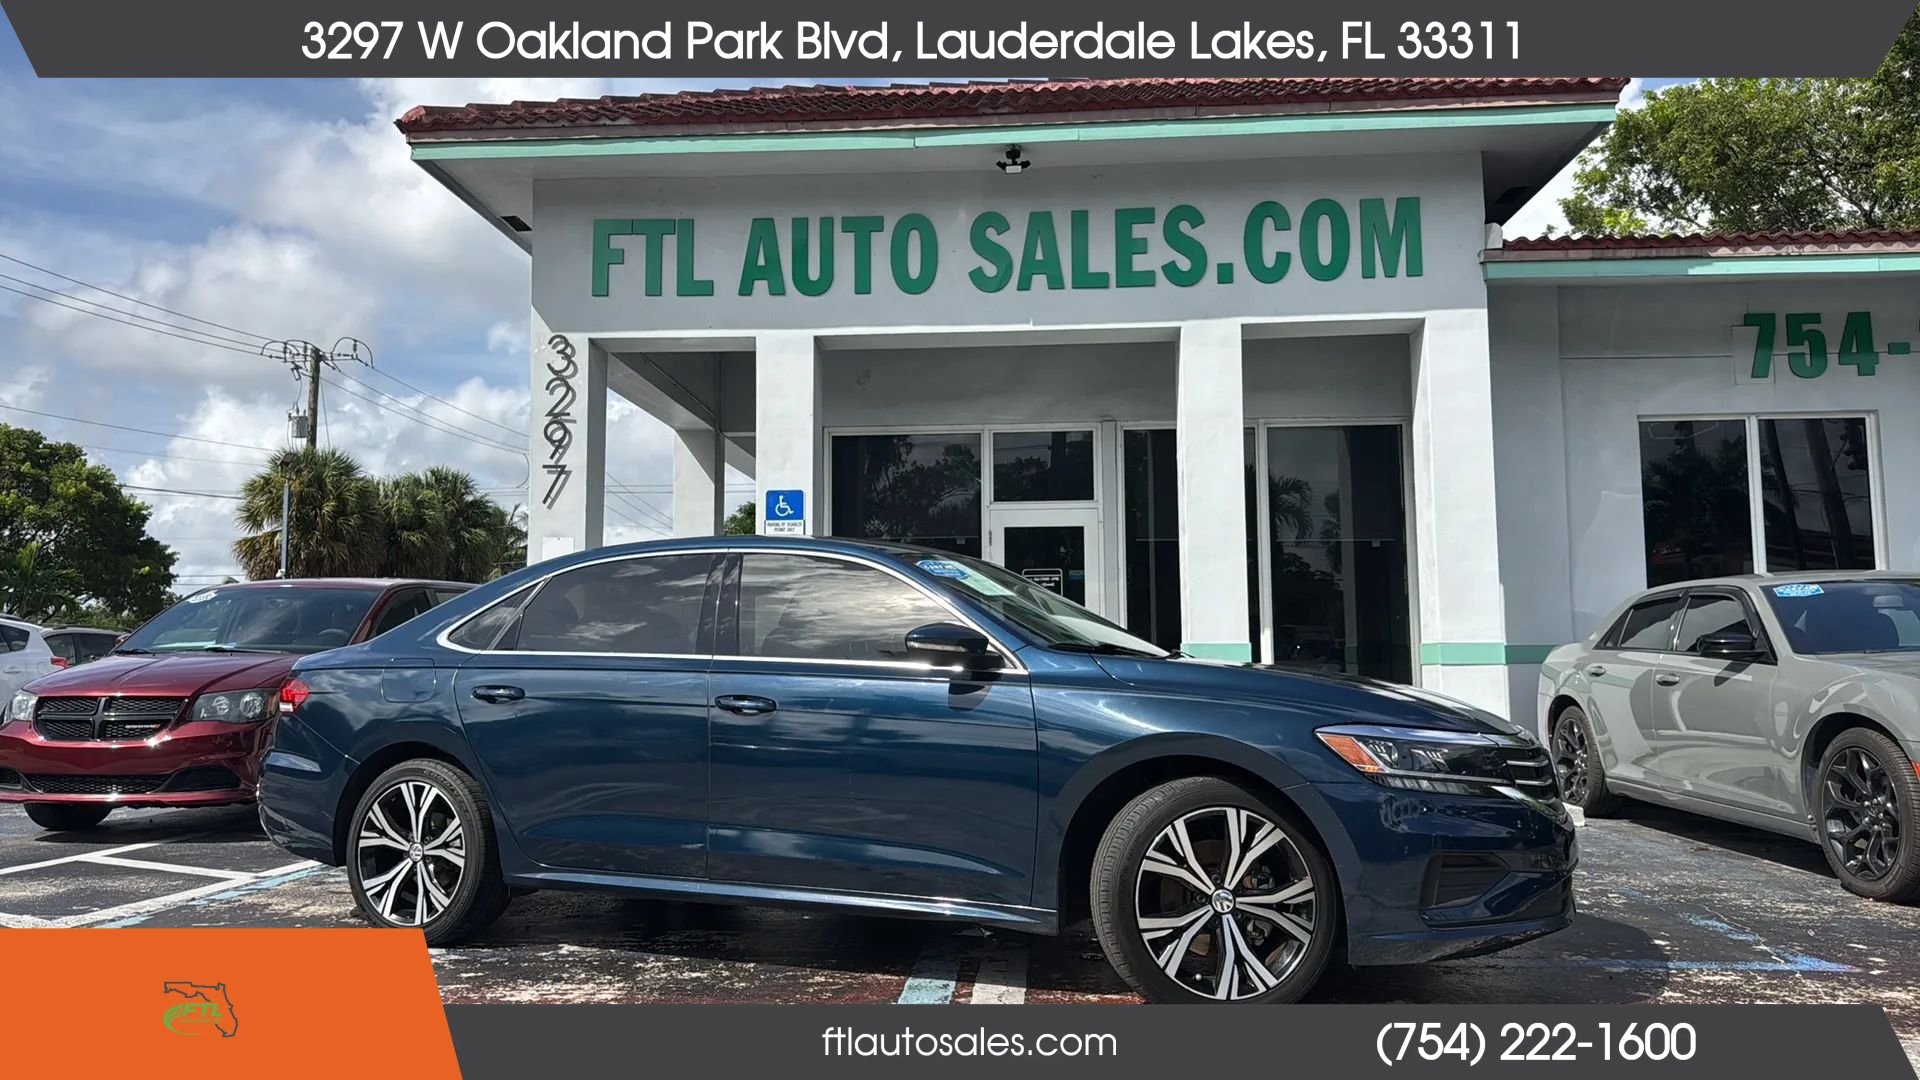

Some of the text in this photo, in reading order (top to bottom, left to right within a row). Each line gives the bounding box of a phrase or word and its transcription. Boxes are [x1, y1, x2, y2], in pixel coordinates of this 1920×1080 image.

[592, 197, 1423, 297] FTL AUTO SALES.COM
[1743, 311, 1920, 379] 754-
[542, 334, 576, 508] 3297
